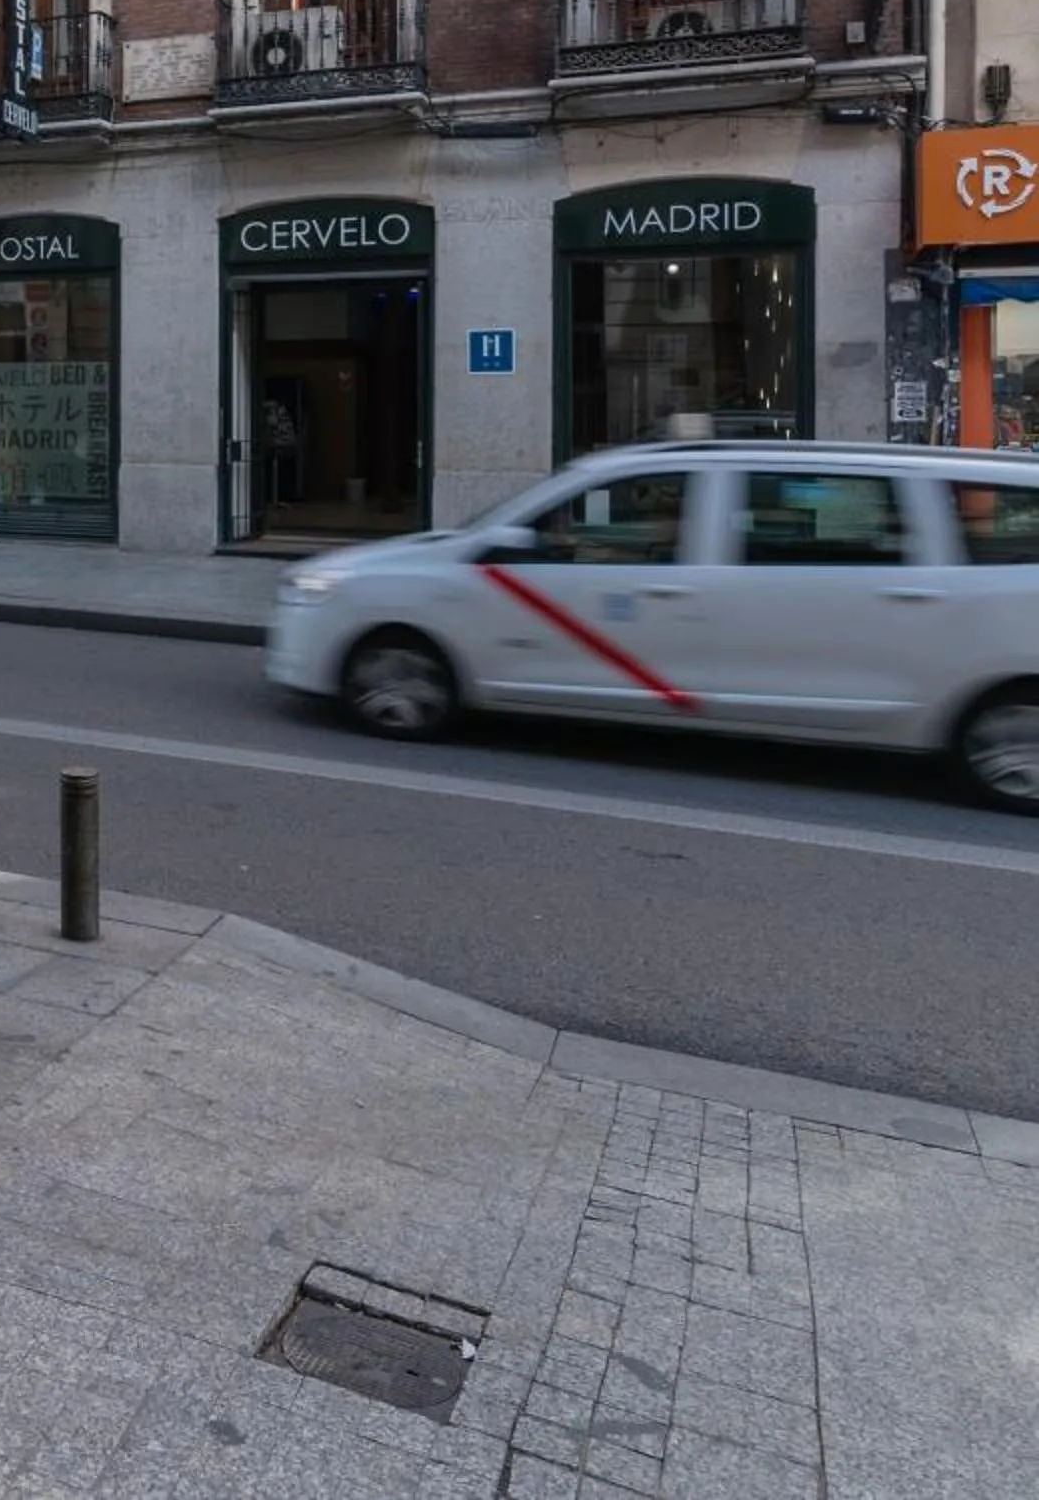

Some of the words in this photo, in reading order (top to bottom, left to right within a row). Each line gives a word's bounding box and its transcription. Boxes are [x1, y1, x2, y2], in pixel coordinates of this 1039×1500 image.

[983, 164, 1011, 196] R
[240, 213, 410, 252] CERVELO
[603, 201, 761, 237] MADRID
[87, 391, 107, 495] BREAKFAST
